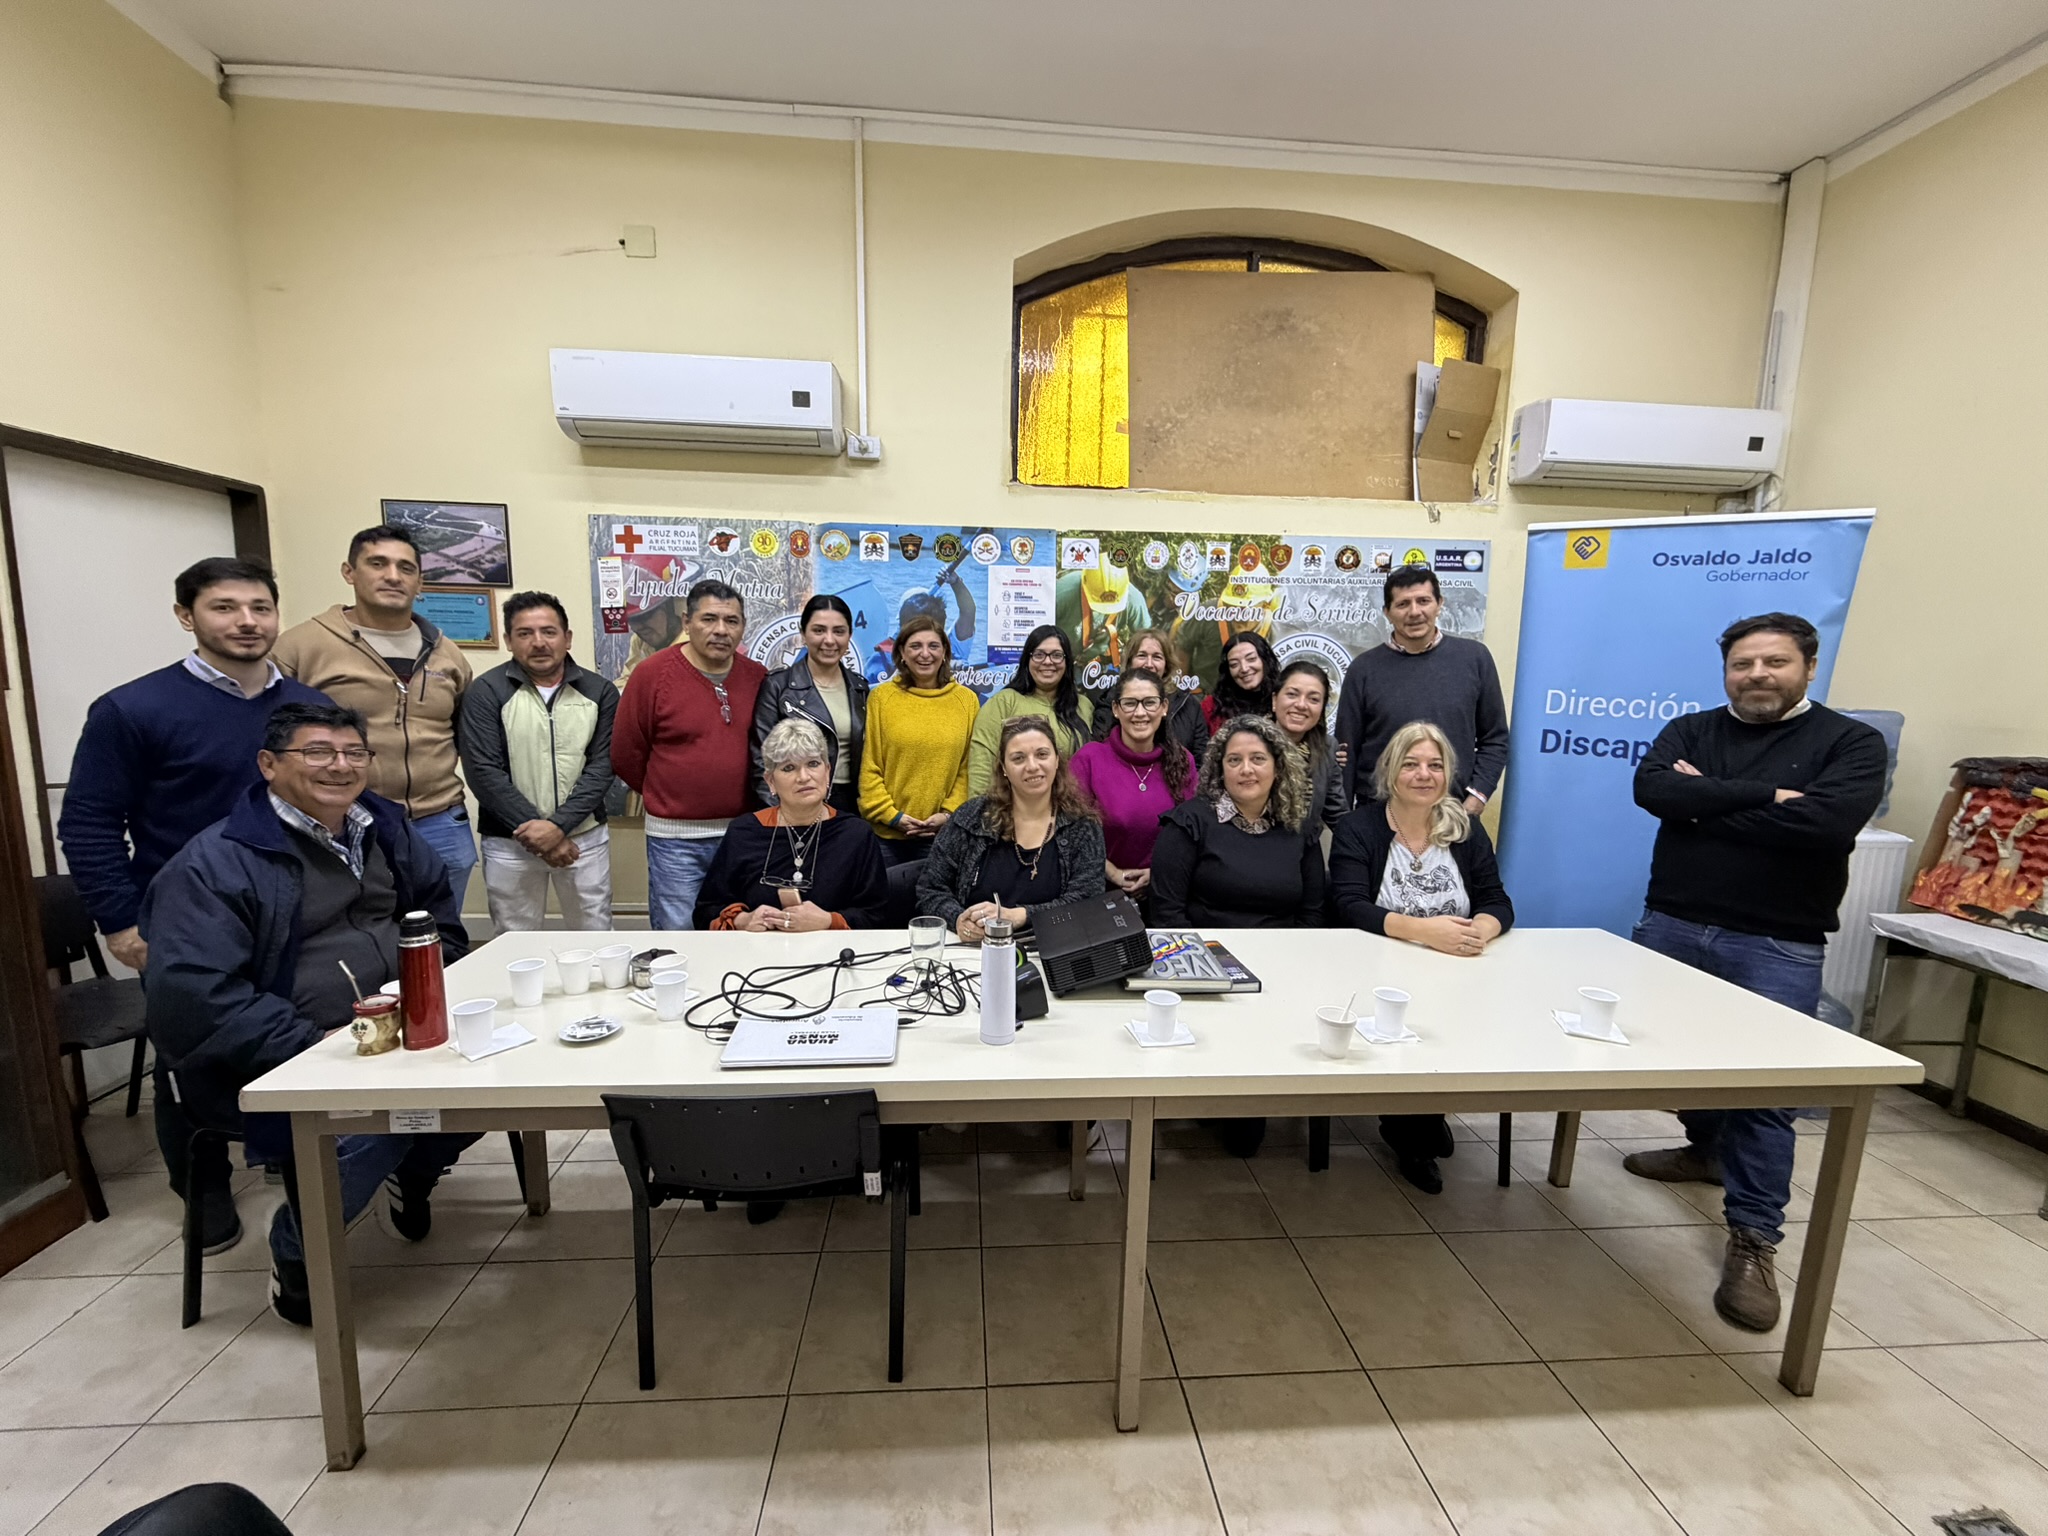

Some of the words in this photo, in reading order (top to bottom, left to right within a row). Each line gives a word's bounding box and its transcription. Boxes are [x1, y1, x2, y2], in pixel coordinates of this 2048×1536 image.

[648, 529, 671, 538] CRUZ
[674, 530, 697, 538] ROJA
[1435, 554, 1463, 562] U.S.A.R.
[1652, 550, 1741, 567] Osvaldo
[1746, 548, 1812, 565] Jaldo
[624, 566, 690, 609] Ayuda
[1230, 576, 1291, 585] INSTITUCIONES
[1292, 577, 1345, 586] VOLUNTARIAS
[1347, 578, 1387, 586] AUXILIARE
[1454, 579, 1474, 588] CIVIL
[1706, 569, 1810, 582] Gobernador
[854, 609, 868, 630] 4
[1174, 592, 1264, 622] Vocación
[1271, 594, 1294, 622] de
[1302, 593, 1377, 624] Servicio
[755, 625, 788, 661] EFENSA
[1294, 639, 1319, 649] CIVIL
[1322, 643, 1348, 675] TUCUM
[1545, 689, 1700, 721] Dirección
[1539, 728, 1651, 767] Discap
[1151, 953, 1225, 978] IVEC
